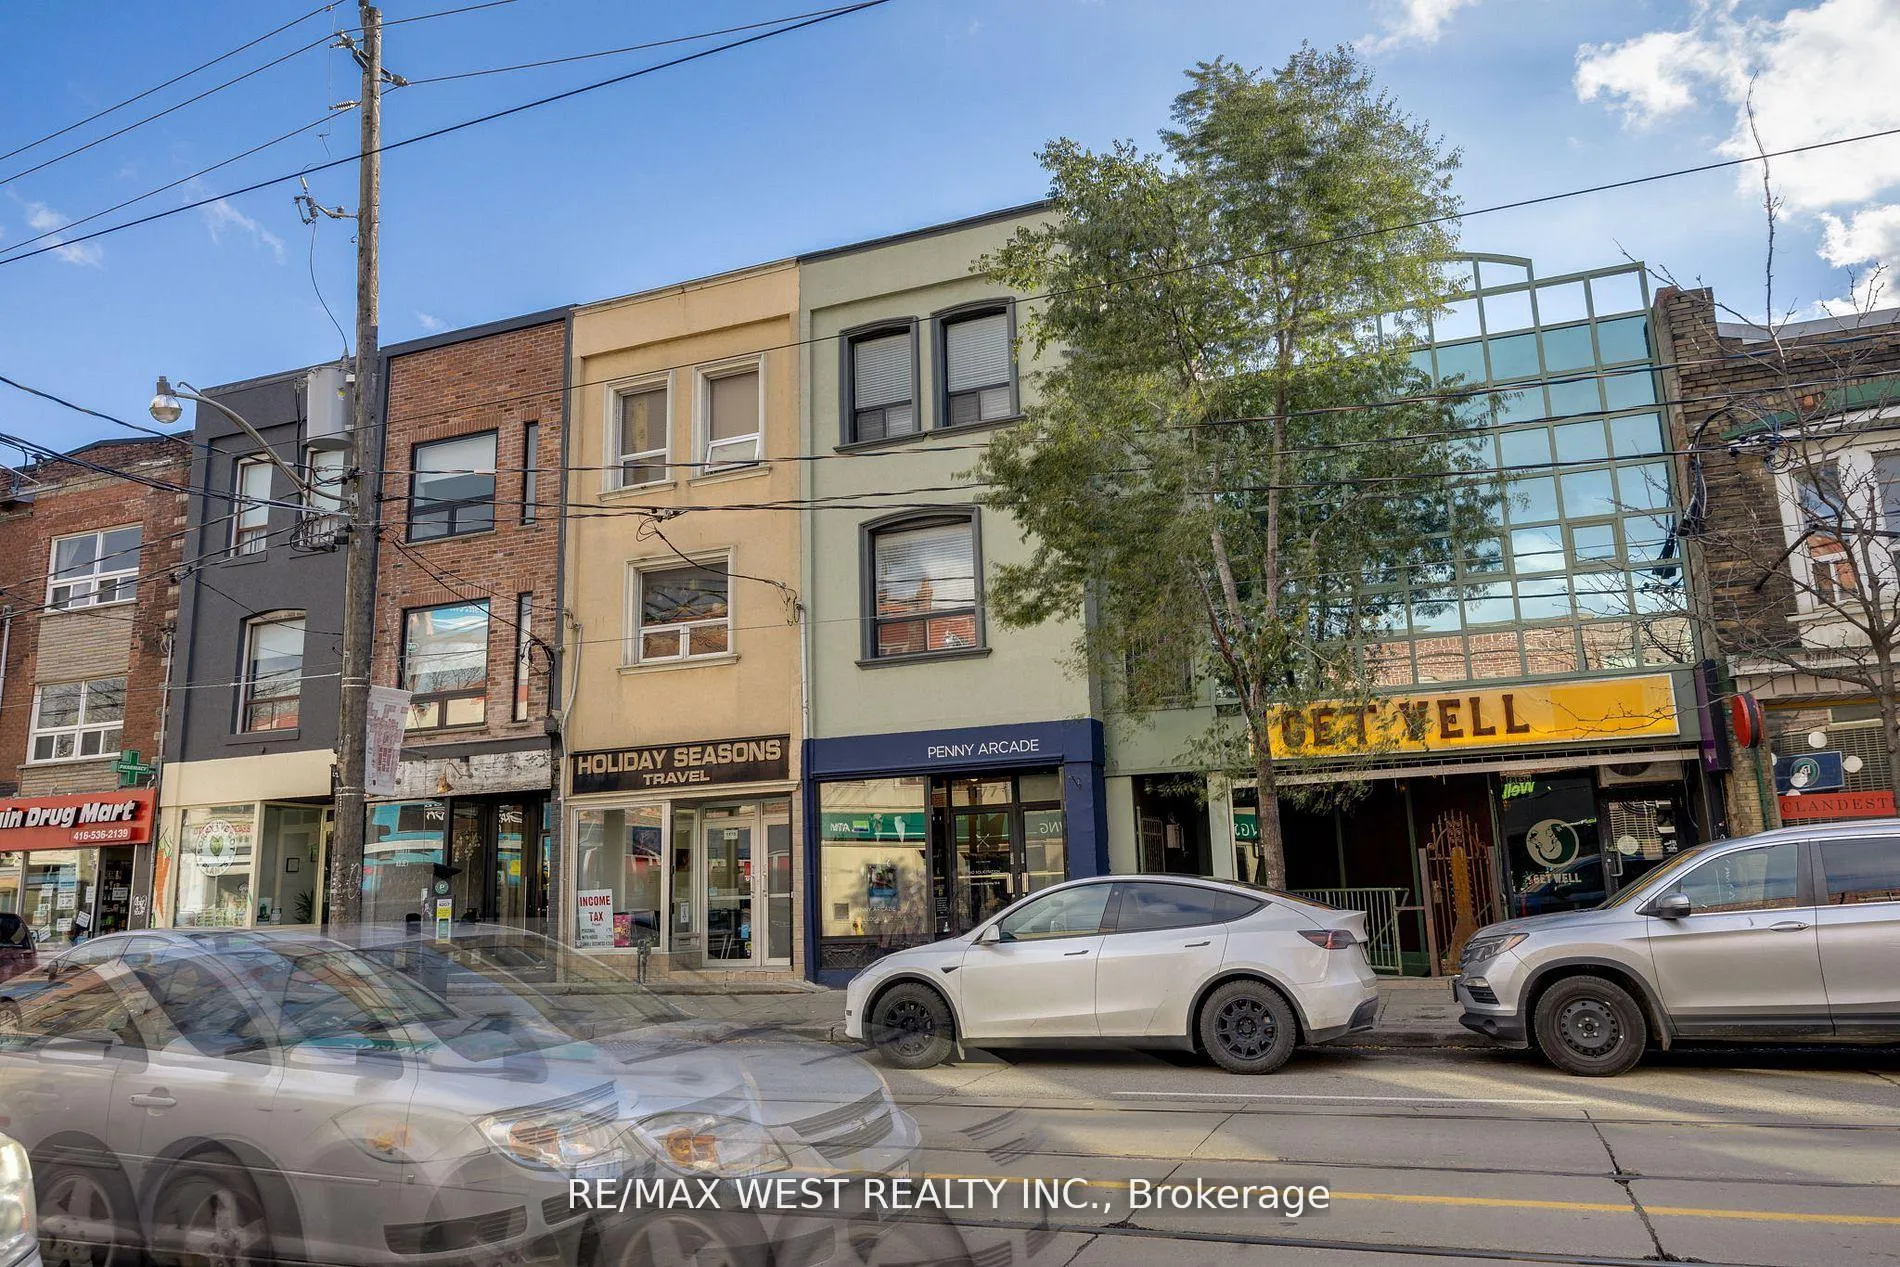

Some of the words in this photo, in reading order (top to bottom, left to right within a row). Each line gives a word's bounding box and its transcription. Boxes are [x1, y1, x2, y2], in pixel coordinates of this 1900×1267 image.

[1280, 704, 1377, 748] GET
[927, 743, 975, 759] PENNY
[977, 738, 1040, 755] ARCADE
[578, 750, 667, 775] HOLIDAY
[674, 740, 781, 766] SEASONS
[119, 763, 148, 771] PHARMACY
[643, 770, 710, 785] TRAVEL
[25, 806, 77, 829] Drug
[79, 799, 136, 824] Mart
[1553, 872, 1582, 884] WELL
[579, 895, 611, 907] INCOME
[589, 911, 604, 922] TAX
